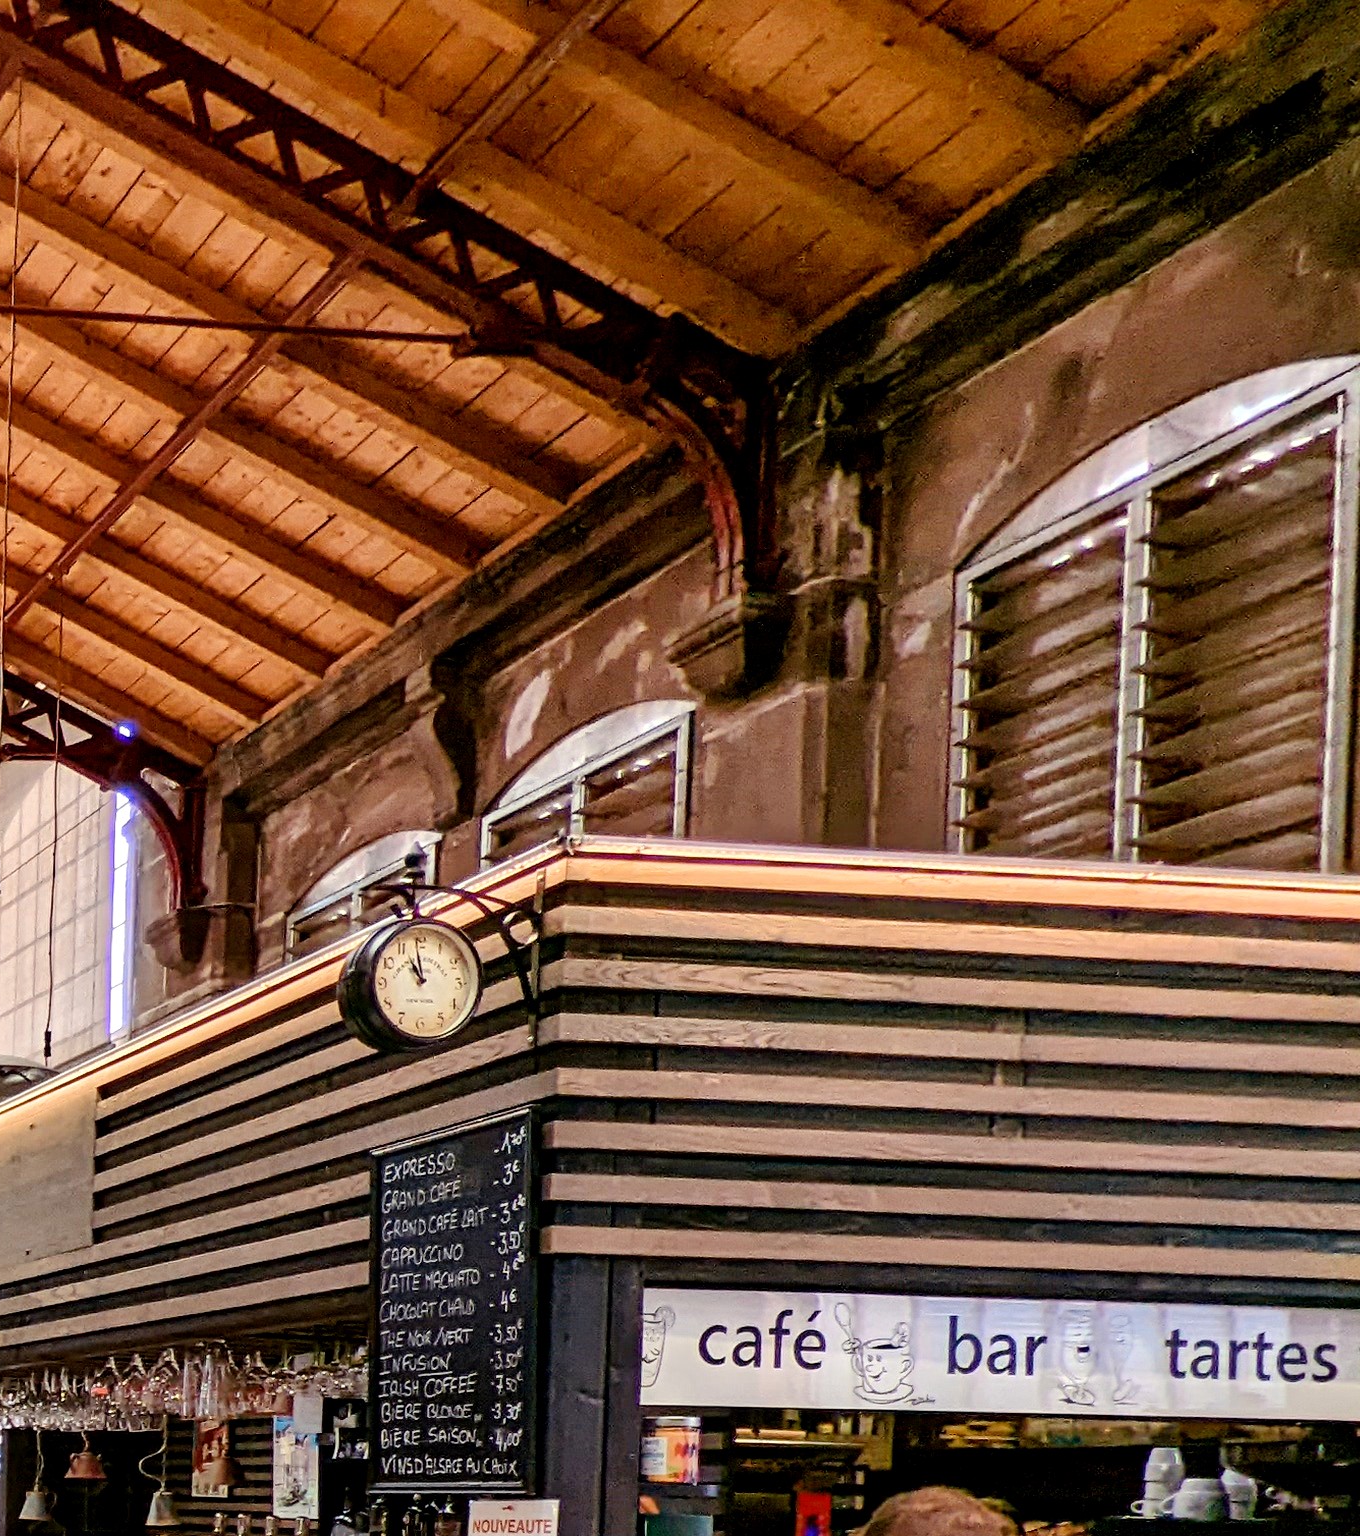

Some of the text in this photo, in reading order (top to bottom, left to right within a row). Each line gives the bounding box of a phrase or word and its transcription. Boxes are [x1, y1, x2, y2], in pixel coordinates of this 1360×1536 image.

[383, 1153, 456, 1183] EXPRESSO
[381, 1189, 426, 1214] GRAND
[430, 1174, 462, 1203] CAFÉ
[381, 1218, 427, 1243] GRAND
[427, 1208, 459, 1235] CAFÉ
[461, 1205, 490, 1229] LAIT
[381, 1244, 464, 1270] CAPPUCCINO
[380, 1271, 421, 1295] LATTE
[380, 1299, 438, 1323] CHOCOLAT
[439, 1297, 475, 1318] CHAUD
[696, 1310, 827, 1370] café
[945, 1316, 1048, 1376] bar
[1164, 1326, 1339, 1383] tartes
[379, 1352, 452, 1376] INFUSION
[378, 1379, 420, 1399] IRISH
[424, 1372, 479, 1399] COFFEE
[381, 1400, 423, 1423] BIÈRE
[426, 1403, 474, 1419] BLONDE
[380, 1428, 421, 1449] BIÈRE
[428, 1426, 476, 1445] SAISON
[381, 1454, 413, 1475] VINS
[466, 1457, 481, 1473] AU
[472, 1518, 553, 1534] NOUVEAUTE
